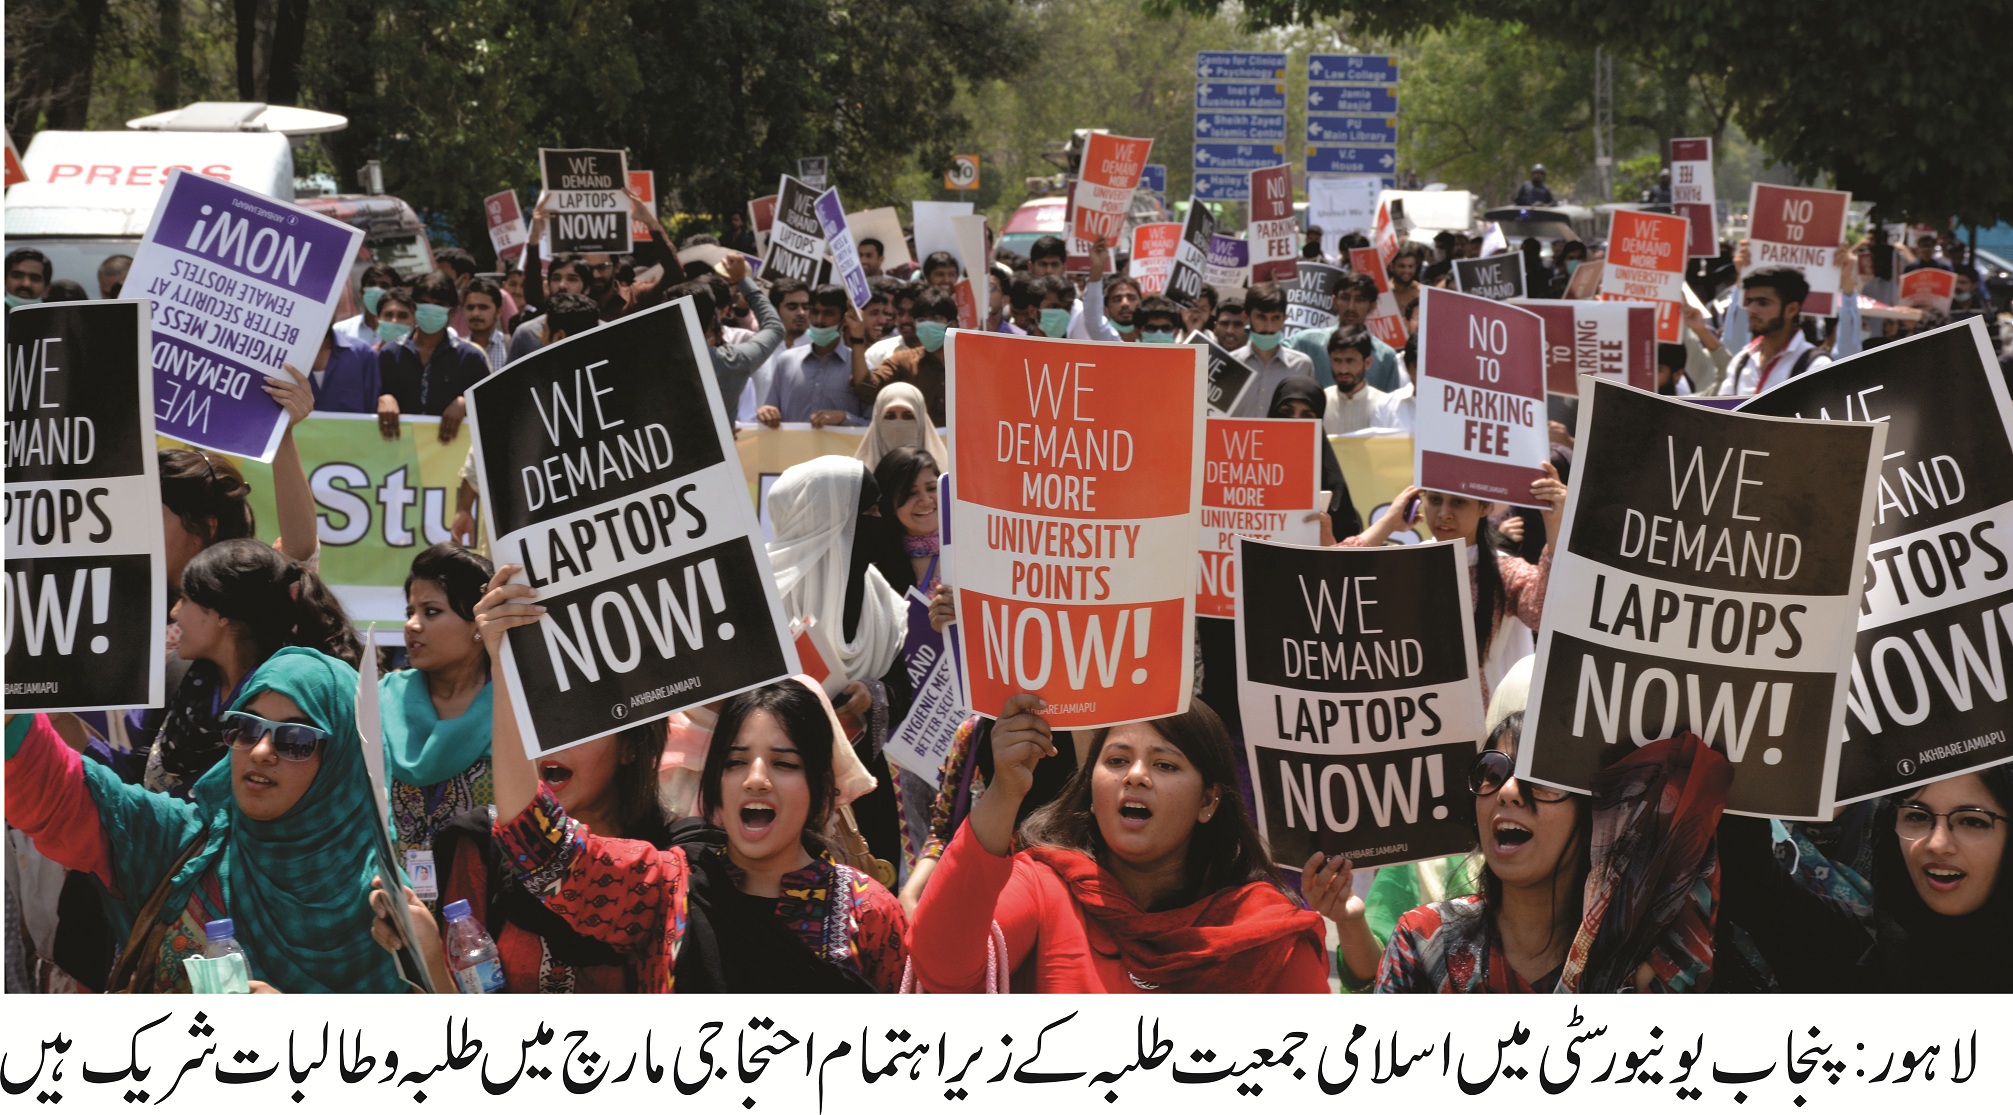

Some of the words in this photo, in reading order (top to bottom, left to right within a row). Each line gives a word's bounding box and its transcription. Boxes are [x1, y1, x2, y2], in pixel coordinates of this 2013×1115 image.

[1199, 54, 1231, 65] Centre
[1232, 54, 1247, 65] for
[1248, 55, 1286, 66] Clinical
[1215, 66, 1273, 79] Psychology
[1348, 57, 1363, 68] PU
[1324, 69, 1346, 80] Law
[1347, 69, 1387, 82] College
[1227, 85, 1247, 96] Inst
[1248, 85, 1260, 96] of
[1249, 96, 1283, 107] Admin
[1340, 88, 1371, 100] Jamia
[1337, 99, 1372, 112] Masjid
[1210, 127, 1248, 138] Islamic
[1249, 127, 1284, 138] Centre
[1213, 114, 1249, 126] Sheikh
[1250, 114, 1282, 128] Zayed
[1346, 118, 1363, 130] PU
[1323, 129, 1348, 141] Main
[1349, 130, 1387, 142] Library
[1114, 142, 1137, 163] WE
[1236, 145, 1253, 157] PU
[568, 156, 599, 175] WE
[1101, 158, 1139, 176] DEMAND
[1331, 160, 1365, 172] House
[561, 174, 612, 189] DEMAND
[1108, 174, 1130, 188] MORE
[1213, 187, 1225, 197] of
[1266, 176, 1286, 200] NO
[558, 192, 617, 209] LAPTOPS
[793, 190, 816, 217] WE
[1272, 200, 1285, 217] TO
[1782, 198, 1814, 224] NO
[559, 213, 618, 240] NOW!
[786, 208, 819, 234] DEMAND
[1148, 226, 1167, 239] WE
[1634, 217, 1662, 241] WE
[1786, 224, 1805, 241] TO
[185, 204, 312, 287] NOW!
[1142, 239, 1175, 251] DEMAND
[1215, 237, 1237, 257] WE
[1268, 237, 1291, 257] FEE
[1621, 236, 1672, 258] DEMAND
[1760, 243, 1826, 267] PARKING
[770, 246, 812, 283] NOW!
[1475, 264, 1504, 286] WE
[1629, 254, 1659, 270] MORE
[147, 276, 168, 297] AT
[170, 258, 237, 297] HOSTELS
[1298, 270, 1328, 293] WE
[1615, 267, 1670, 286] UNIVERSITY
[1623, 282, 1659, 298] POINTS
[170, 283, 244, 325] SECURITY
[242, 282, 296, 319] FEMALE
[1286, 288, 1334, 311] DEMAND
[159, 305, 210, 340] MESS
[246, 311, 301, 346] BETTER
[1469, 314, 1508, 356] NO
[207, 322, 288, 370] HYGIENIC
[1552, 345, 1572, 364] TO
[1577, 320, 1598, 376] ARKING
[1599, 340, 1623, 374] FEE
[6, 337, 63, 413] WE
[151, 340, 252, 401] DEMAND
[1475, 355, 1501, 383] TO
[529, 359, 625, 448] WE
[1023, 357, 1097, 423] WE
[154, 379, 213, 434] WE
[1443, 384, 1534, 428] PARKING
[997, 420, 1135, 473] DEMAND
[1221, 428, 1265, 461] WE
[1464, 419, 1510, 458] FEE
[521, 423, 674, 512] DEMAND
[1206, 460, 1285, 487] DEMAND
[1667, 435, 1771, 522] WE
[1021, 471, 1098, 513] MORE
[1222, 486, 1266, 508] MORE
[1200, 508, 1288, 532] UNIVERSITY
[518, 483, 708, 589] LAPTOPS
[986, 513, 1142, 560] UNIVERSITY
[1619, 507, 1803, 581] DEMAND
[1011, 559, 1112, 601] POINTS
[1298, 573, 1384, 636] WE
[1588, 573, 1808, 660] LAPTOPS
[539, 557, 737, 693] NOW!
[981, 599, 1153, 691] NOW!
[1282, 637, 1424, 681] DEMAND
[629, 676, 702, 709] AKHBAREJAMIAPU
[900, 686, 939, 746] HYGIENIC
[1274, 691, 1442, 745] LAPTOPS
[1571, 652, 1795, 766] NOW!
[914, 714, 944, 758] BETTER
[931, 724, 959, 758] FEMALE
[1918, 730, 2007, 765] AKHBAREJAMIAPU
[1278, 752, 1450, 834] NOW!
